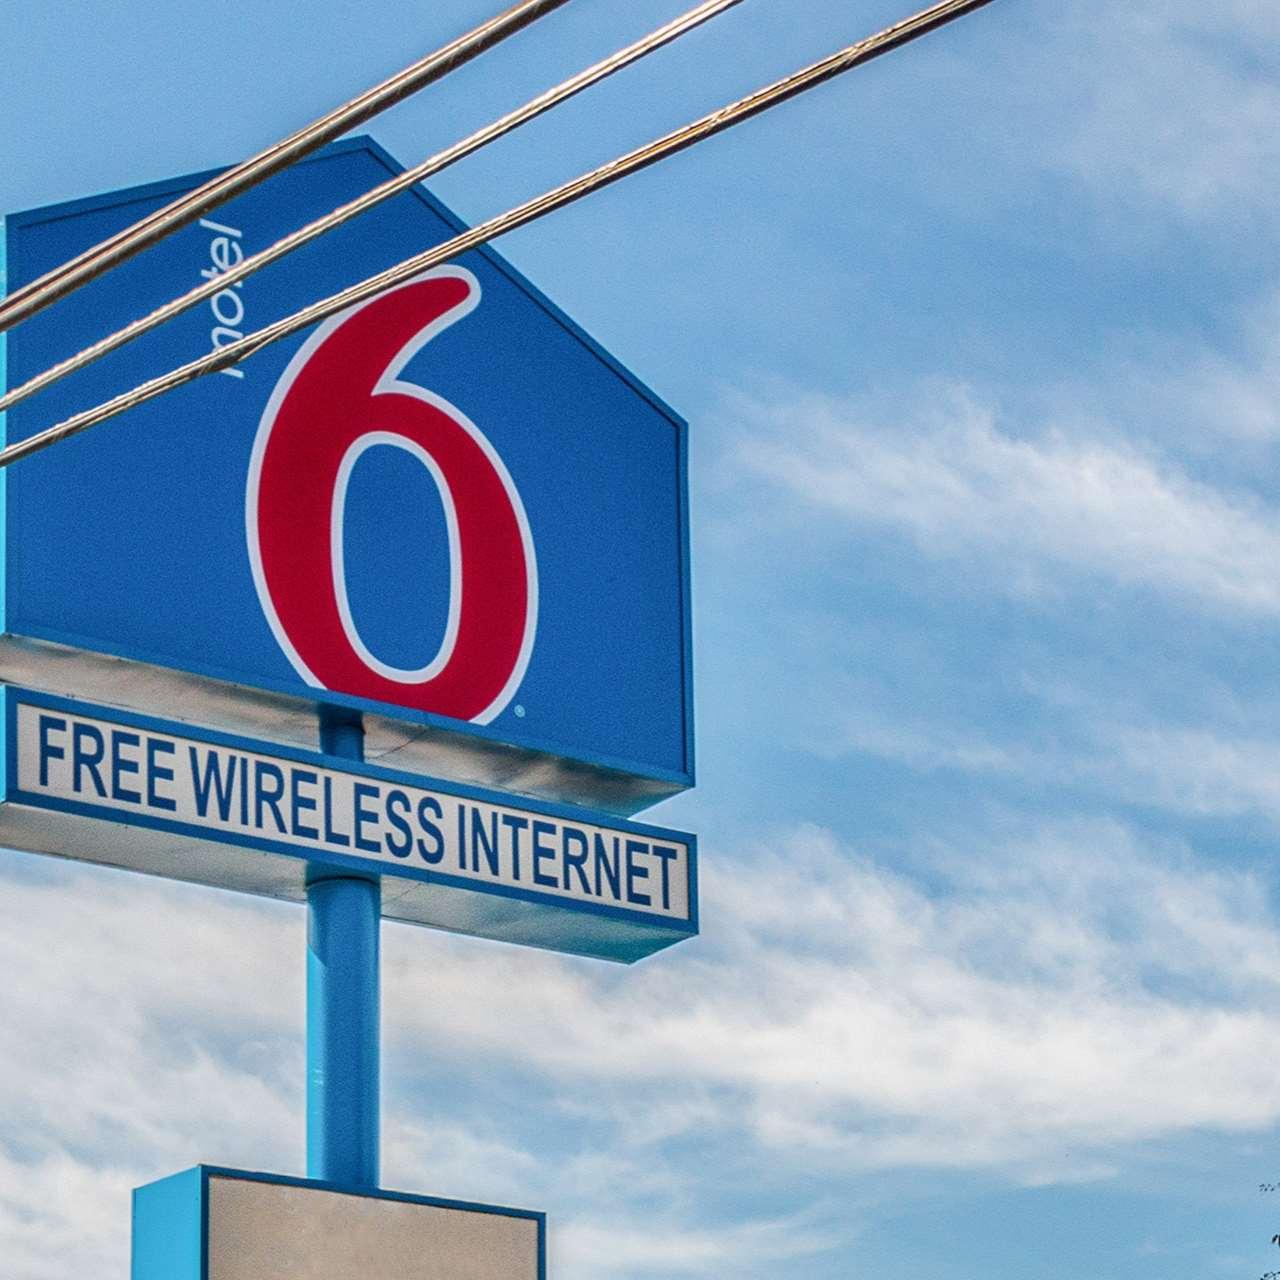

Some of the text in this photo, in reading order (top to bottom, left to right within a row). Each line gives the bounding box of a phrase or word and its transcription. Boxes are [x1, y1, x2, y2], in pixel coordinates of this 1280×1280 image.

[245, 264, 539, 725] 6
[39, 714, 678, 911] FREE WIRELESS INTERNET
